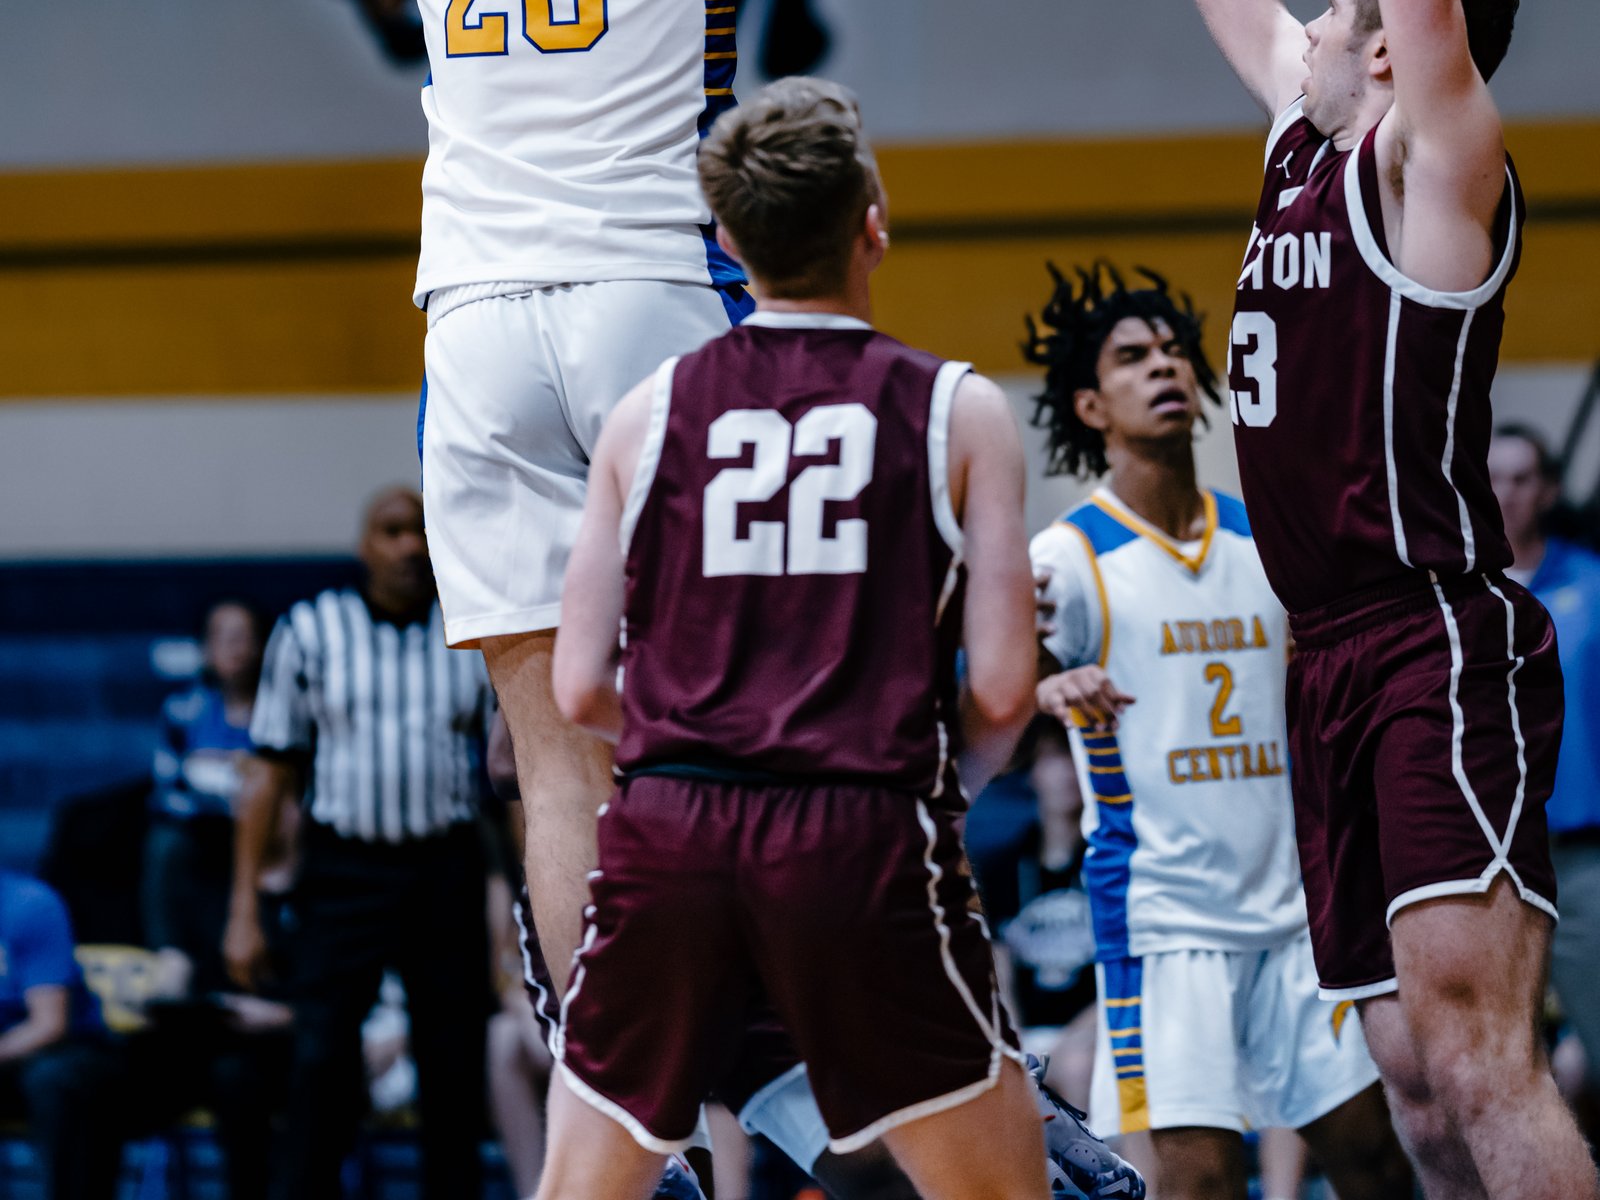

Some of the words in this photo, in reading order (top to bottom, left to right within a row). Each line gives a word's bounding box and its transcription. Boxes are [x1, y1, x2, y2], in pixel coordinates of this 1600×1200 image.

[1237, 221, 1332, 291] TON
[1227, 311, 1278, 426] 3
[703, 403, 877, 577] 22
[1161, 614, 1269, 655] AURORA
[1204, 663, 1243, 737] 2
[1167, 741, 1283, 785] CENTRAL
